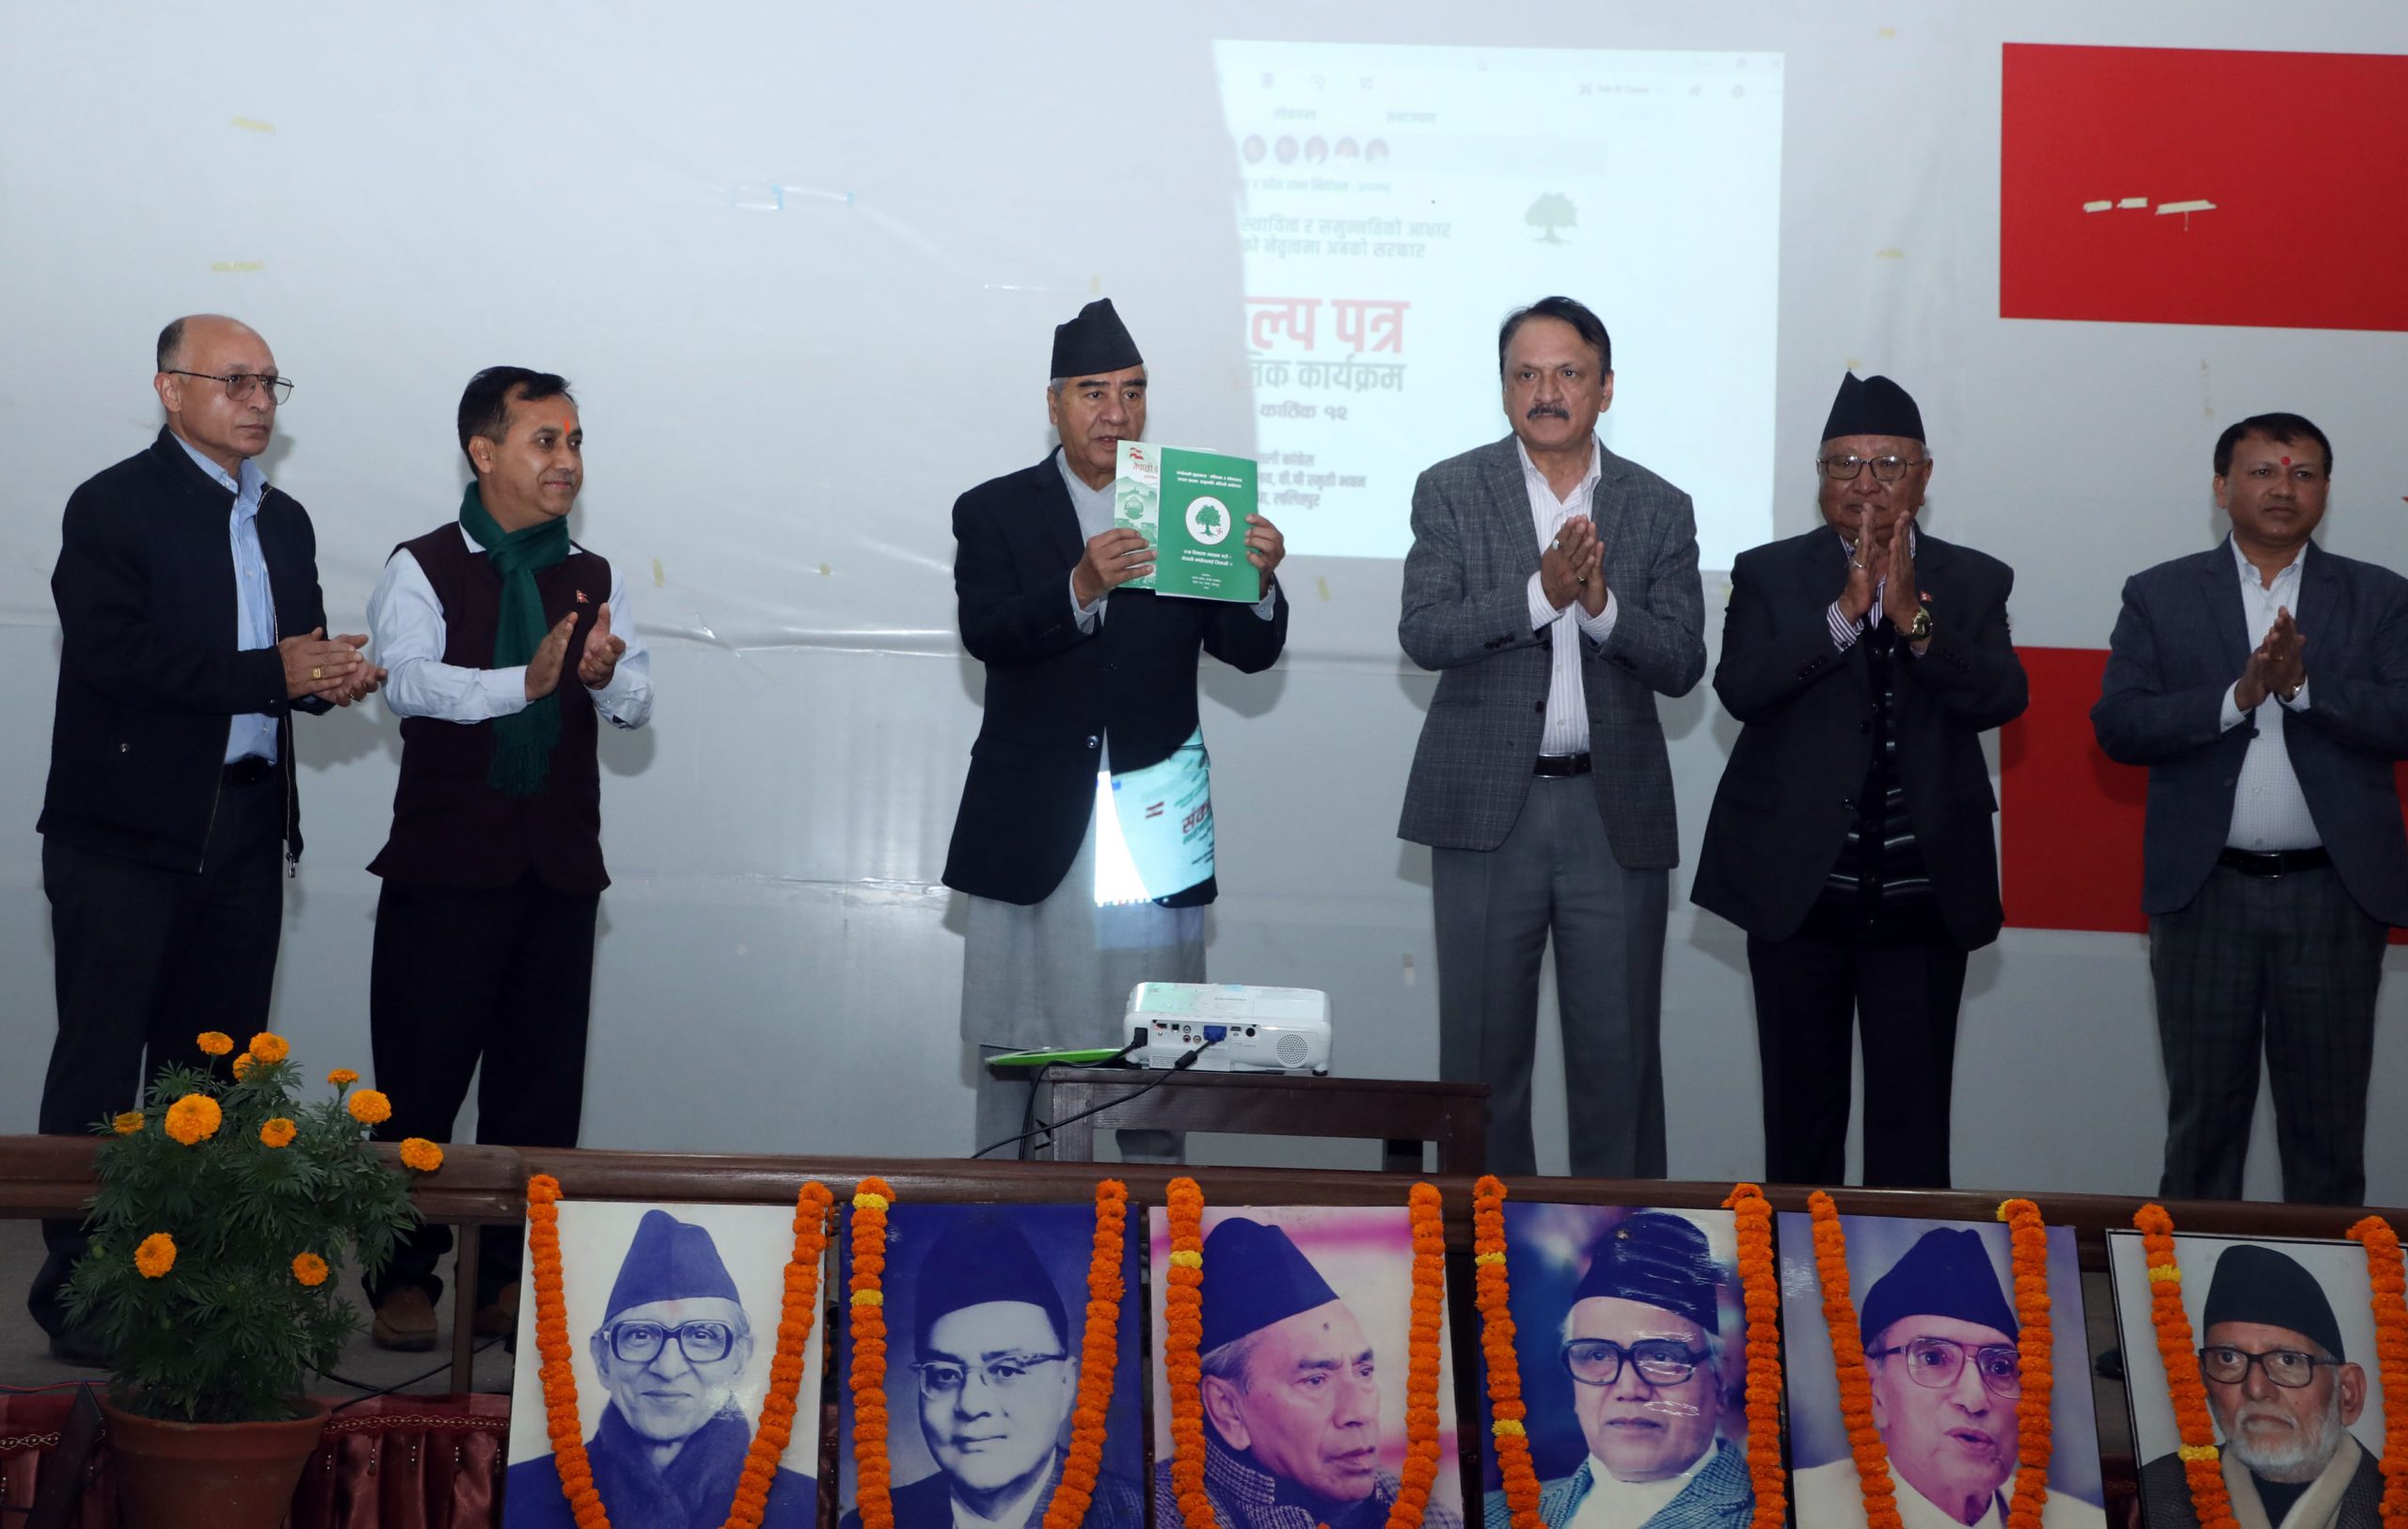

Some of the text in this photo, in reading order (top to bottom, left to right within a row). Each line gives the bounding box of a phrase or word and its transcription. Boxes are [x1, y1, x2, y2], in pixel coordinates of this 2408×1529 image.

[1305, 217, 1314, 234] र
[1405, 220, 1452, 239] आधार
[1324, 236, 1369, 257] अबको
[1372, 242, 1426, 259] सरकार
[1330, 298, 1411, 355] पत्र
[1295, 353, 1407, 393] कार्यक्रम
[1323, 405, 1349, 421] १२
